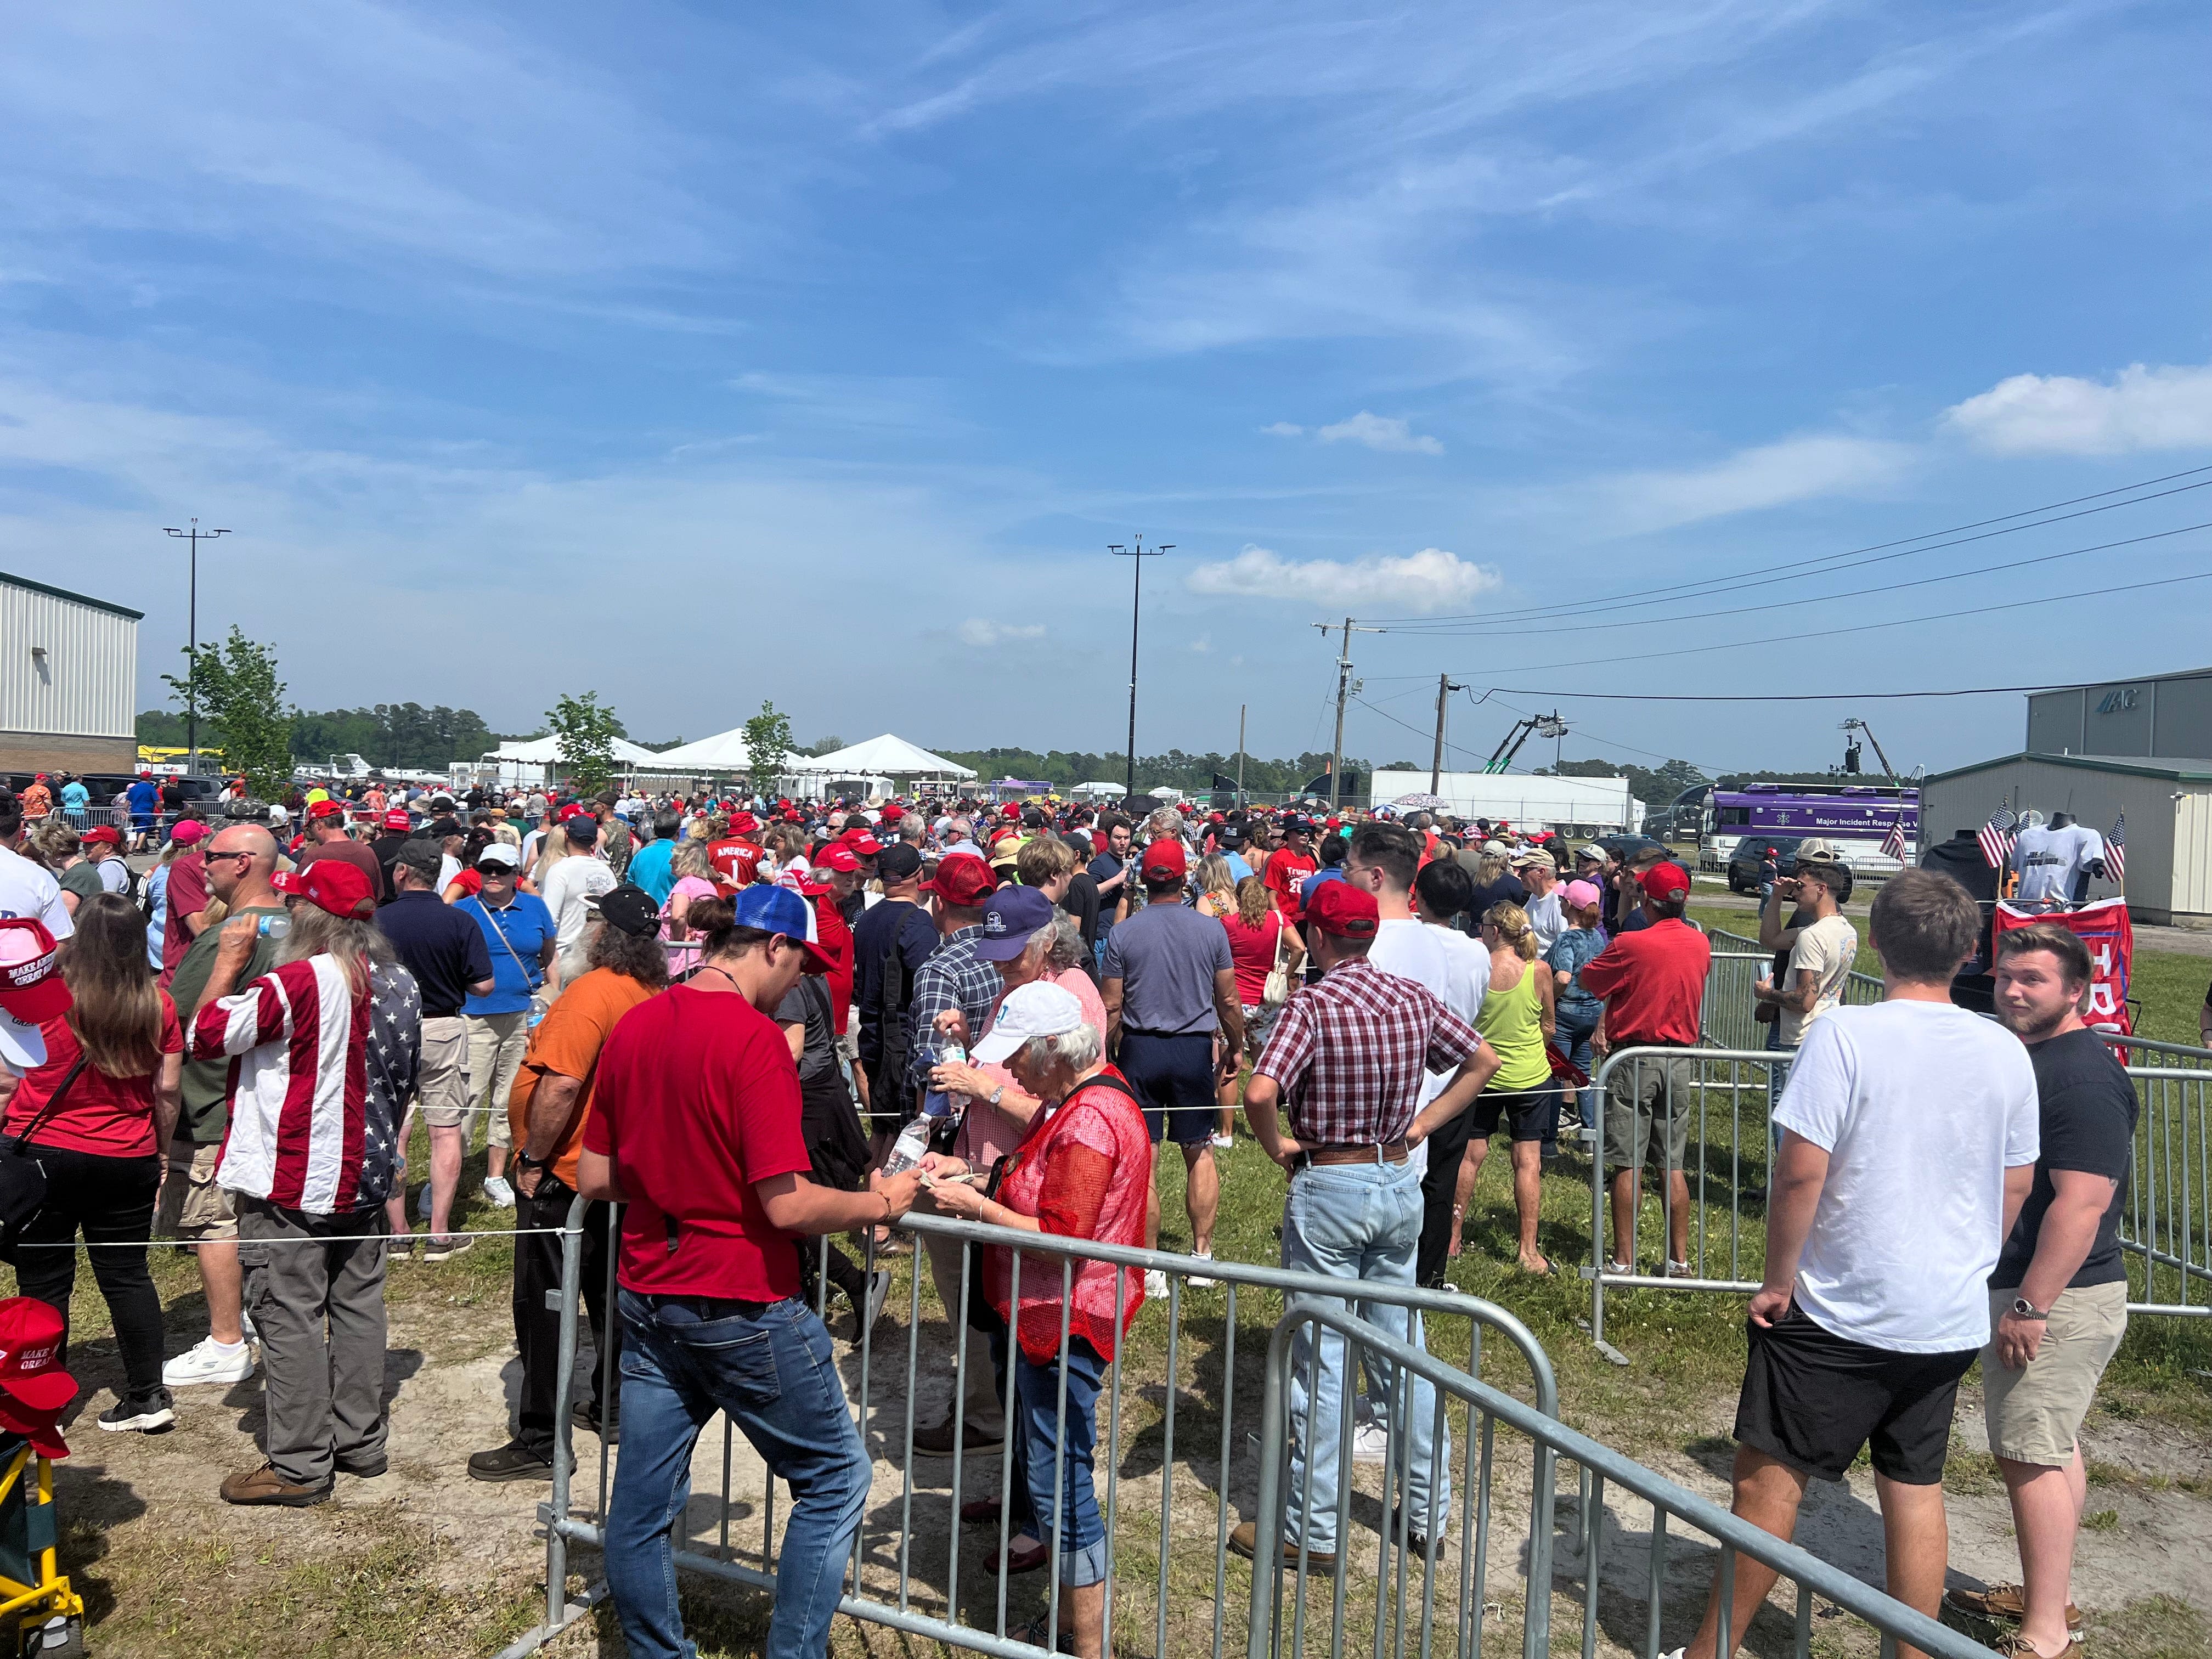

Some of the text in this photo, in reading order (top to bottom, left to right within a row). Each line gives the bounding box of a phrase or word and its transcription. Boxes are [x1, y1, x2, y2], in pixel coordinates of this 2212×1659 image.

[1816, 818, 1838, 826] Major
[718, 847, 753, 860] AMERICA
[732, 859, 738, 882] 1
[1286, 867, 1312, 878] Trump
[644, 912, 661, 921] USA
[8, 962, 36, 979] MAKE
[14, 969, 43, 986] GREAT
[20, 1347, 50, 1360] MAKE
